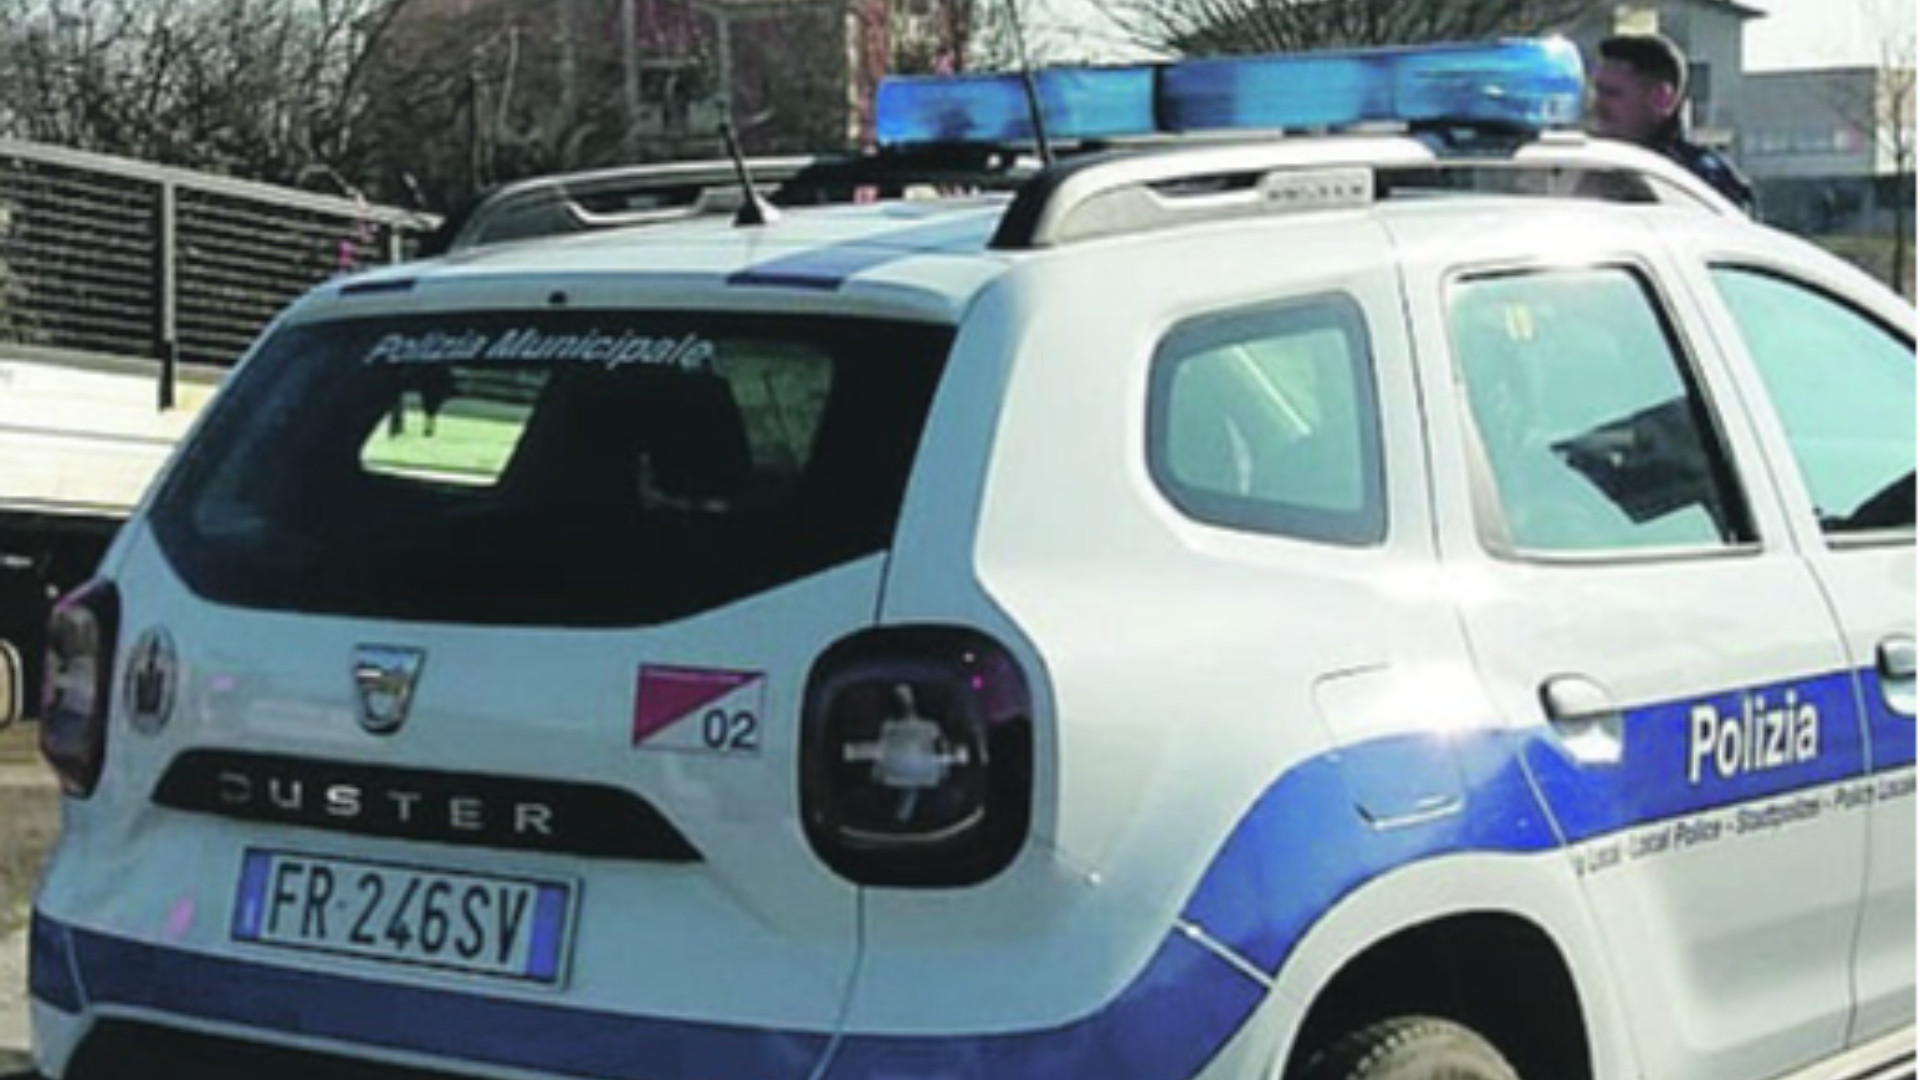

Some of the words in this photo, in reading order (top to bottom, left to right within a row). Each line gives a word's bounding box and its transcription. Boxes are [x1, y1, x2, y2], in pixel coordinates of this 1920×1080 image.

[363, 329, 487, 364] Polizia
[484, 328, 714, 370] Municipale
[703, 708, 757, 750] 02
[1688, 689, 1818, 783] Polizia
[268, 862, 336, 939] FR
[349, 873, 529, 964] 246SV
